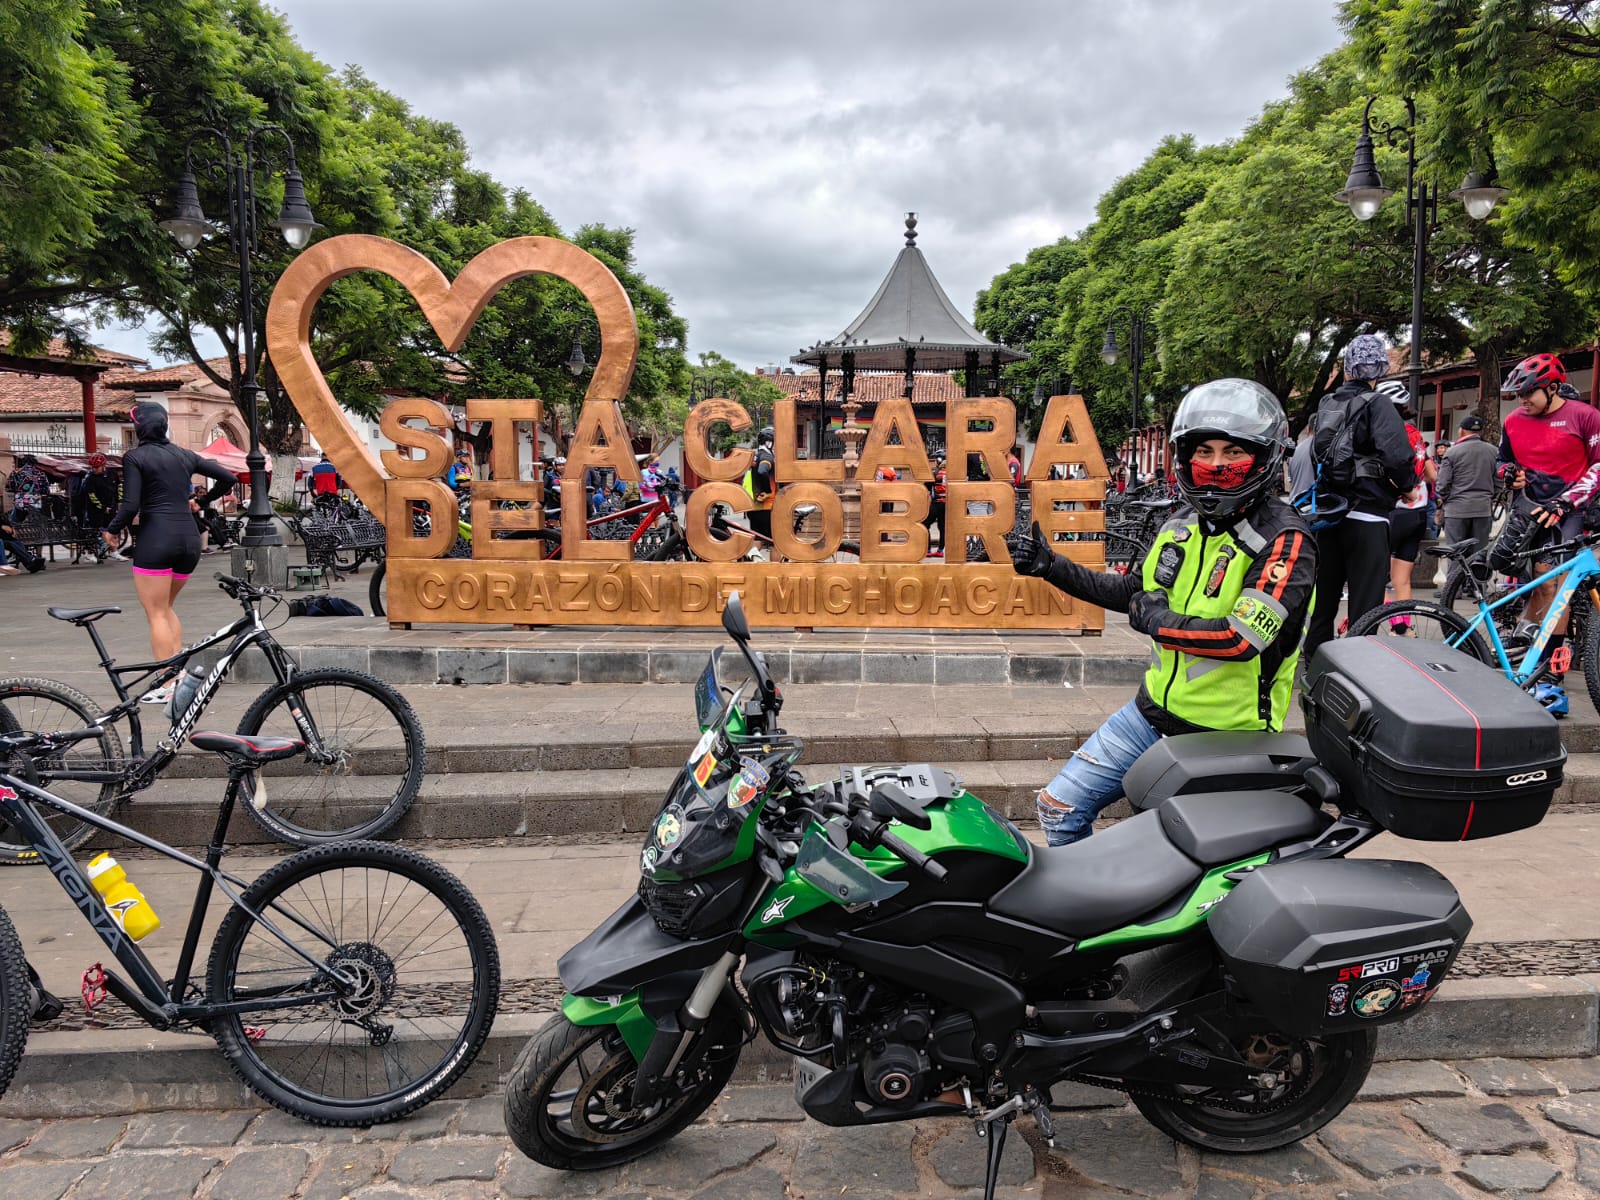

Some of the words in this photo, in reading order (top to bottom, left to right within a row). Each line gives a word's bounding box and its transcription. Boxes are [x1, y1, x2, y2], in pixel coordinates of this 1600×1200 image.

[380, 397, 643, 482] STA
[683, 394, 1110, 482] CLARA
[385, 479, 634, 561] DEL
[685, 480, 1106, 564] COBRE
[416, 564, 662, 612] CORAZÓN
[681, 575, 745, 613] DE
[1507, 771, 1546, 785] UFO
[33, 838, 122, 953] ZIGNA
[1402, 950, 1448, 964] SHAD
[434, 1060, 457, 1084] ROCK
